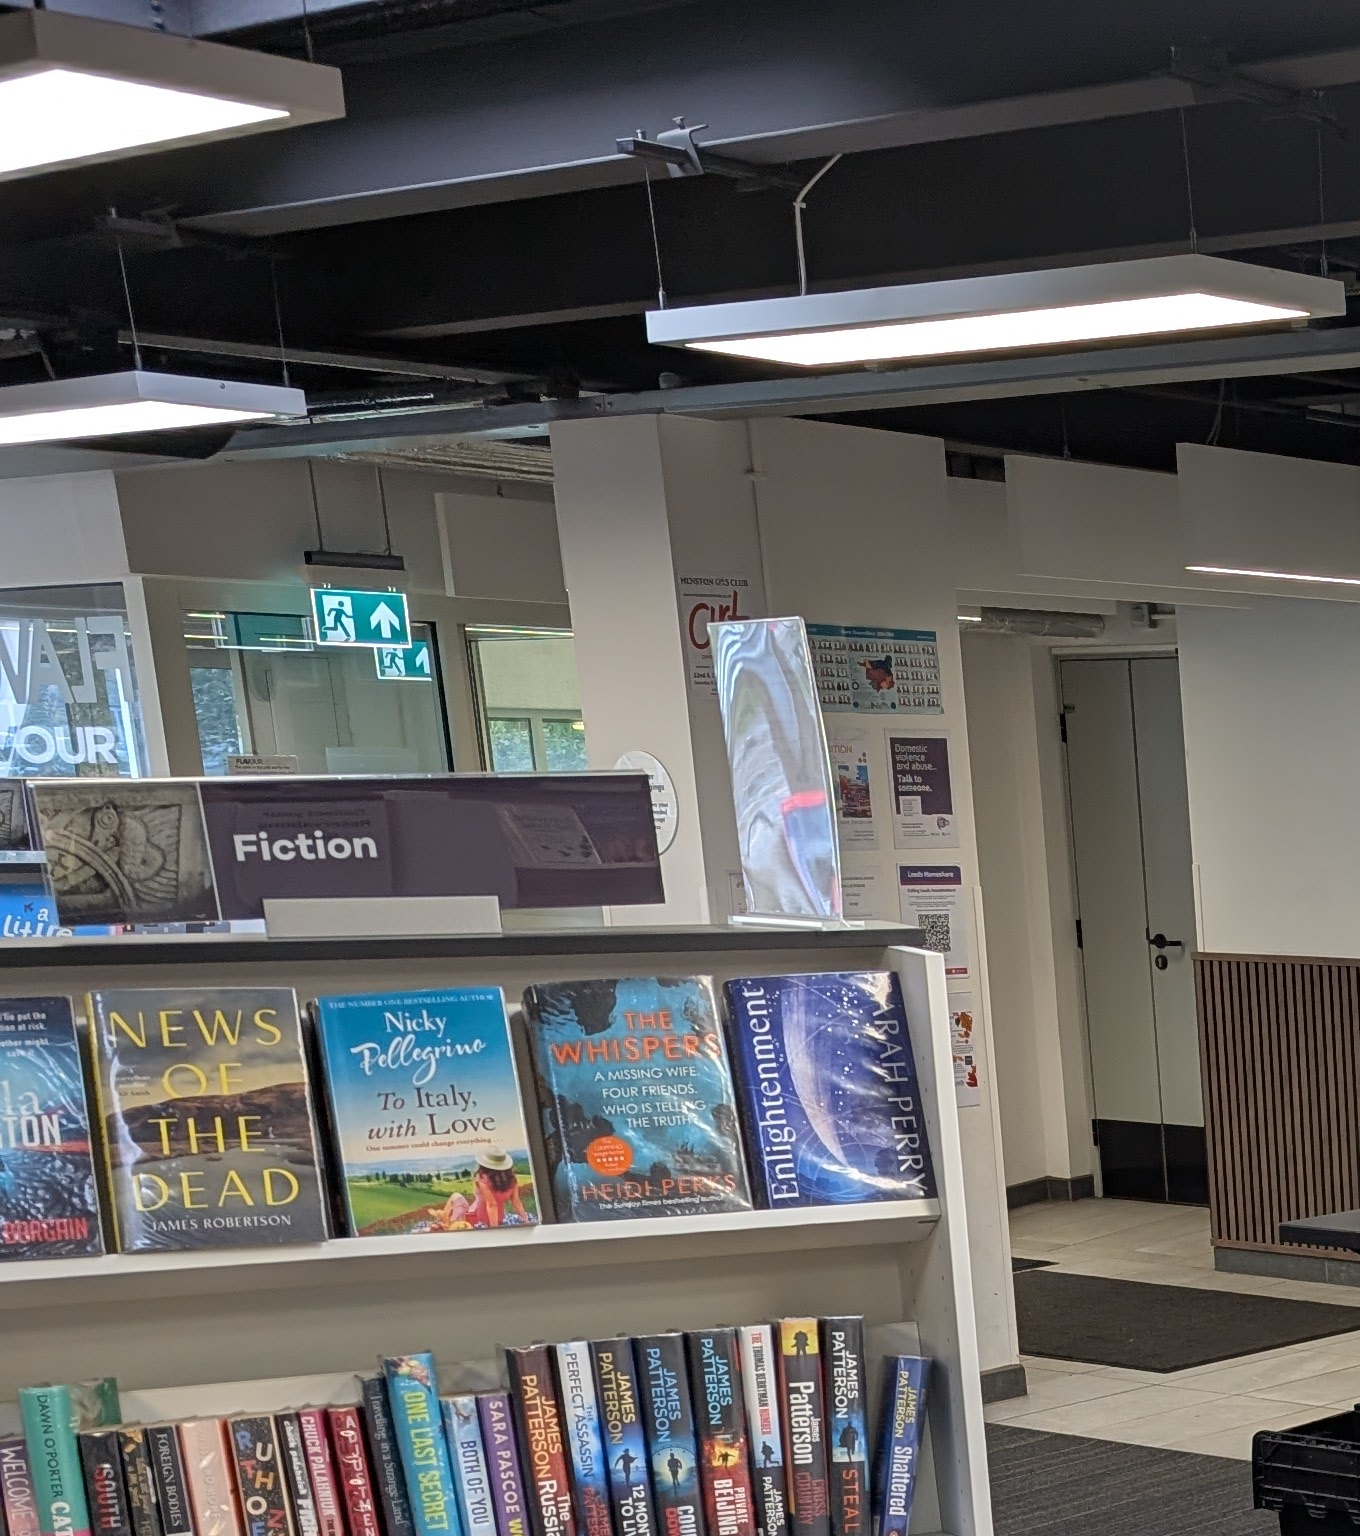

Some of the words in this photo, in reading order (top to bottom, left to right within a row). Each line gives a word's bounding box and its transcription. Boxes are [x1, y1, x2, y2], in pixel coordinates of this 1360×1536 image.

[894, 743, 928, 753] Domestic
[895, 753, 926, 762] violence
[897, 774, 913, 783] Talk
[913, 775, 922, 783] to
[898, 784, 933, 792] someone.
[233, 829, 378, 862] Fiction
[109, 1008, 283, 1048] NEWS
[383, 1010, 447, 1038] Nicky
[622, 1010, 673, 1031] THE
[350, 1033, 487, 1086] Pellegrino
[550, 1032, 722, 1067] WHISPERS
[161, 1062, 244, 1101] OF
[378, 1091, 406, 1112] To
[415, 1084, 478, 1111] Italy,
[738, 981, 799, 1200] Enlightenment
[602, 1101, 639, 1115] WHO
[640, 1101, 652, 1114] IS
[653, 1099, 708, 1113] TELLING
[147, 1114, 268, 1156] THE
[367, 1119, 417, 1141] with
[427, 1112, 497, 1136] Love
[131, 1166, 300, 1213] DEAD
[150, 1213, 199, 1232] JAMES
[202, 1212, 293, 1231] ROBERTSON
[403, 1391, 430, 1425] ONE
[489, 1400, 507, 1446] SARA
[541, 1395, 563, 1455] JAMES
[788, 1380, 815, 1465] Patterson
[410, 1424, 438, 1469] LAST
[460, 1440, 480, 1476] BOTH
[466, 1477, 484, 1496] OF
[496, 1449, 521, 1515] PASCOE
[888, 1445, 913, 1517] Shattered
[417, 1470, 449, 1531] SECRET
[471, 1497, 490, 1526] YOU
[556, 1491, 571, 1521] The
[842, 1468, 862, 1534] STEAL
